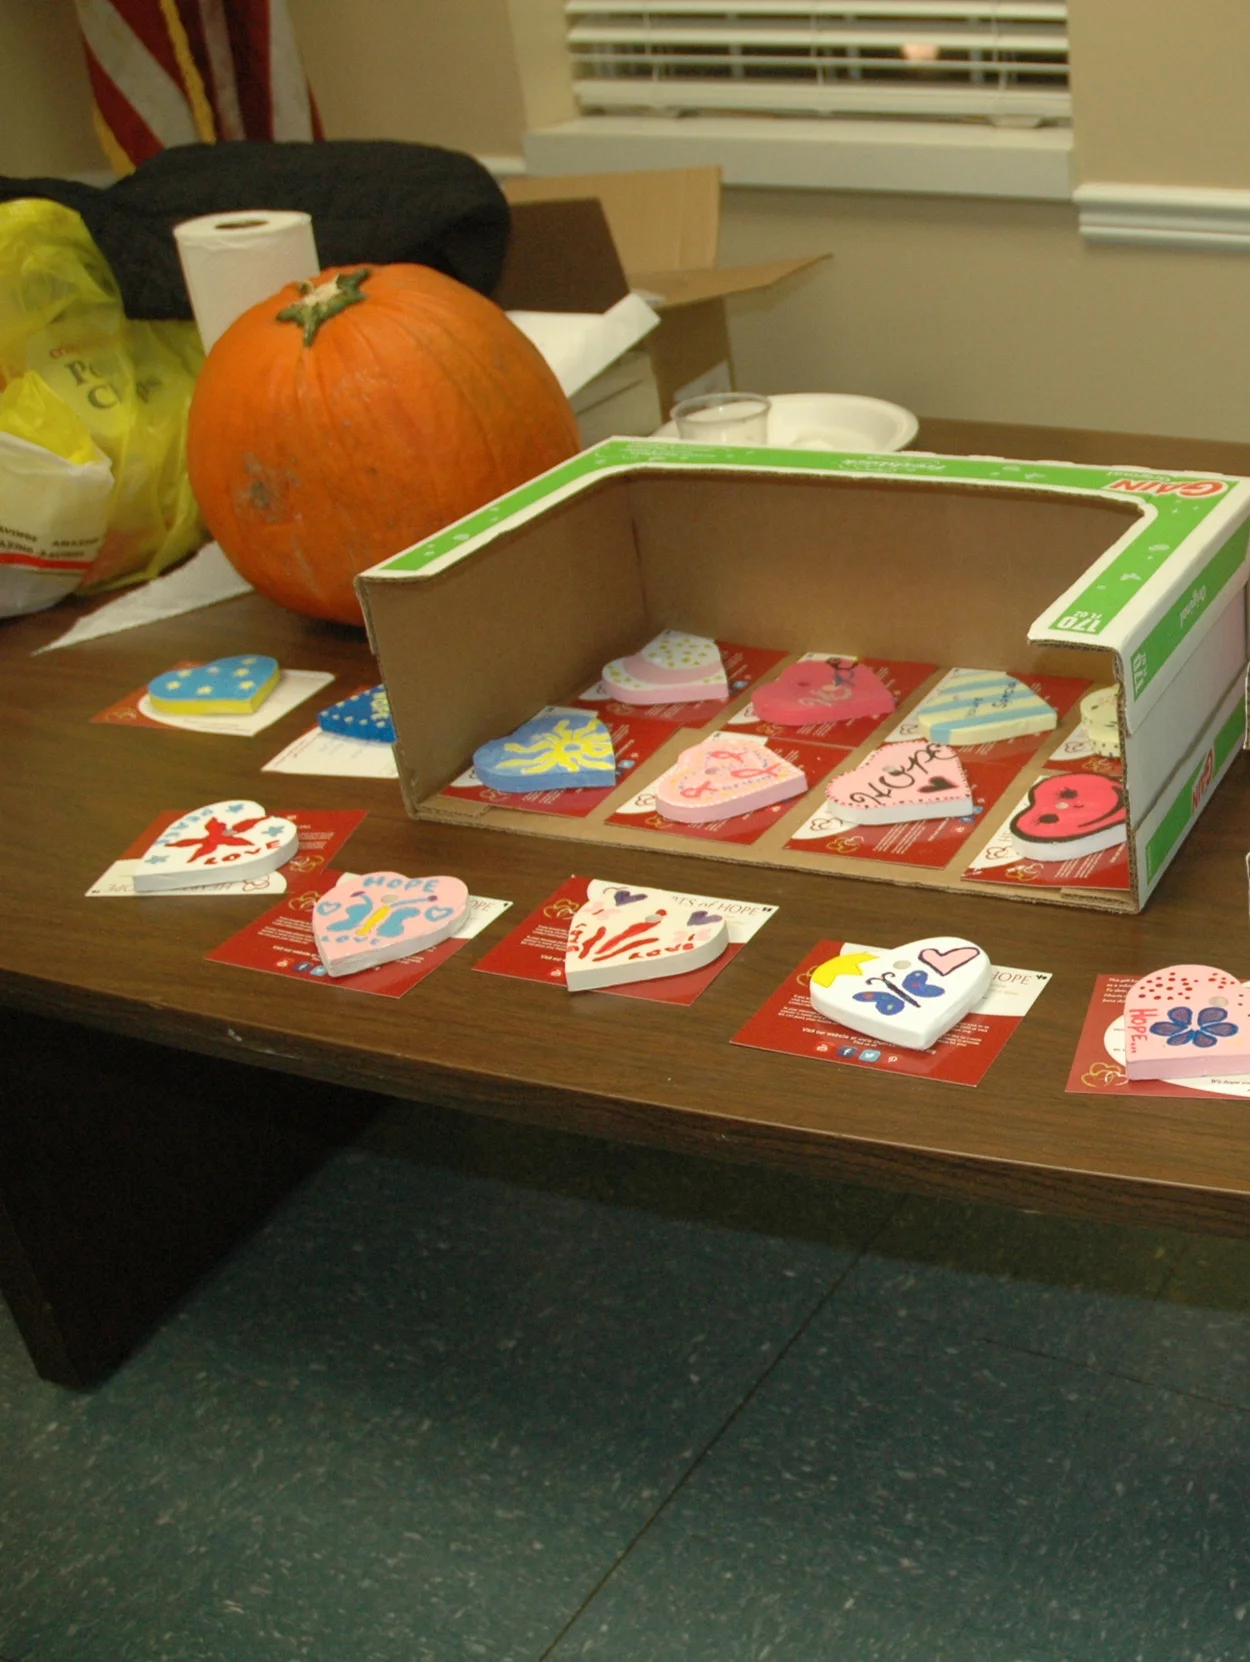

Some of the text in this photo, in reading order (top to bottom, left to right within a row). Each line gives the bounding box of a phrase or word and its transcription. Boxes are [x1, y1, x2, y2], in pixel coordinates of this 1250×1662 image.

[1101, 478, 1228, 498] GAIN
[1056, 615, 1102, 632] 170
[849, 742, 958, 807] HOPE
[203, 839, 281, 865] LOVE
[363, 876, 439, 893] HOPE
[722, 900, 761, 917] HOPE
